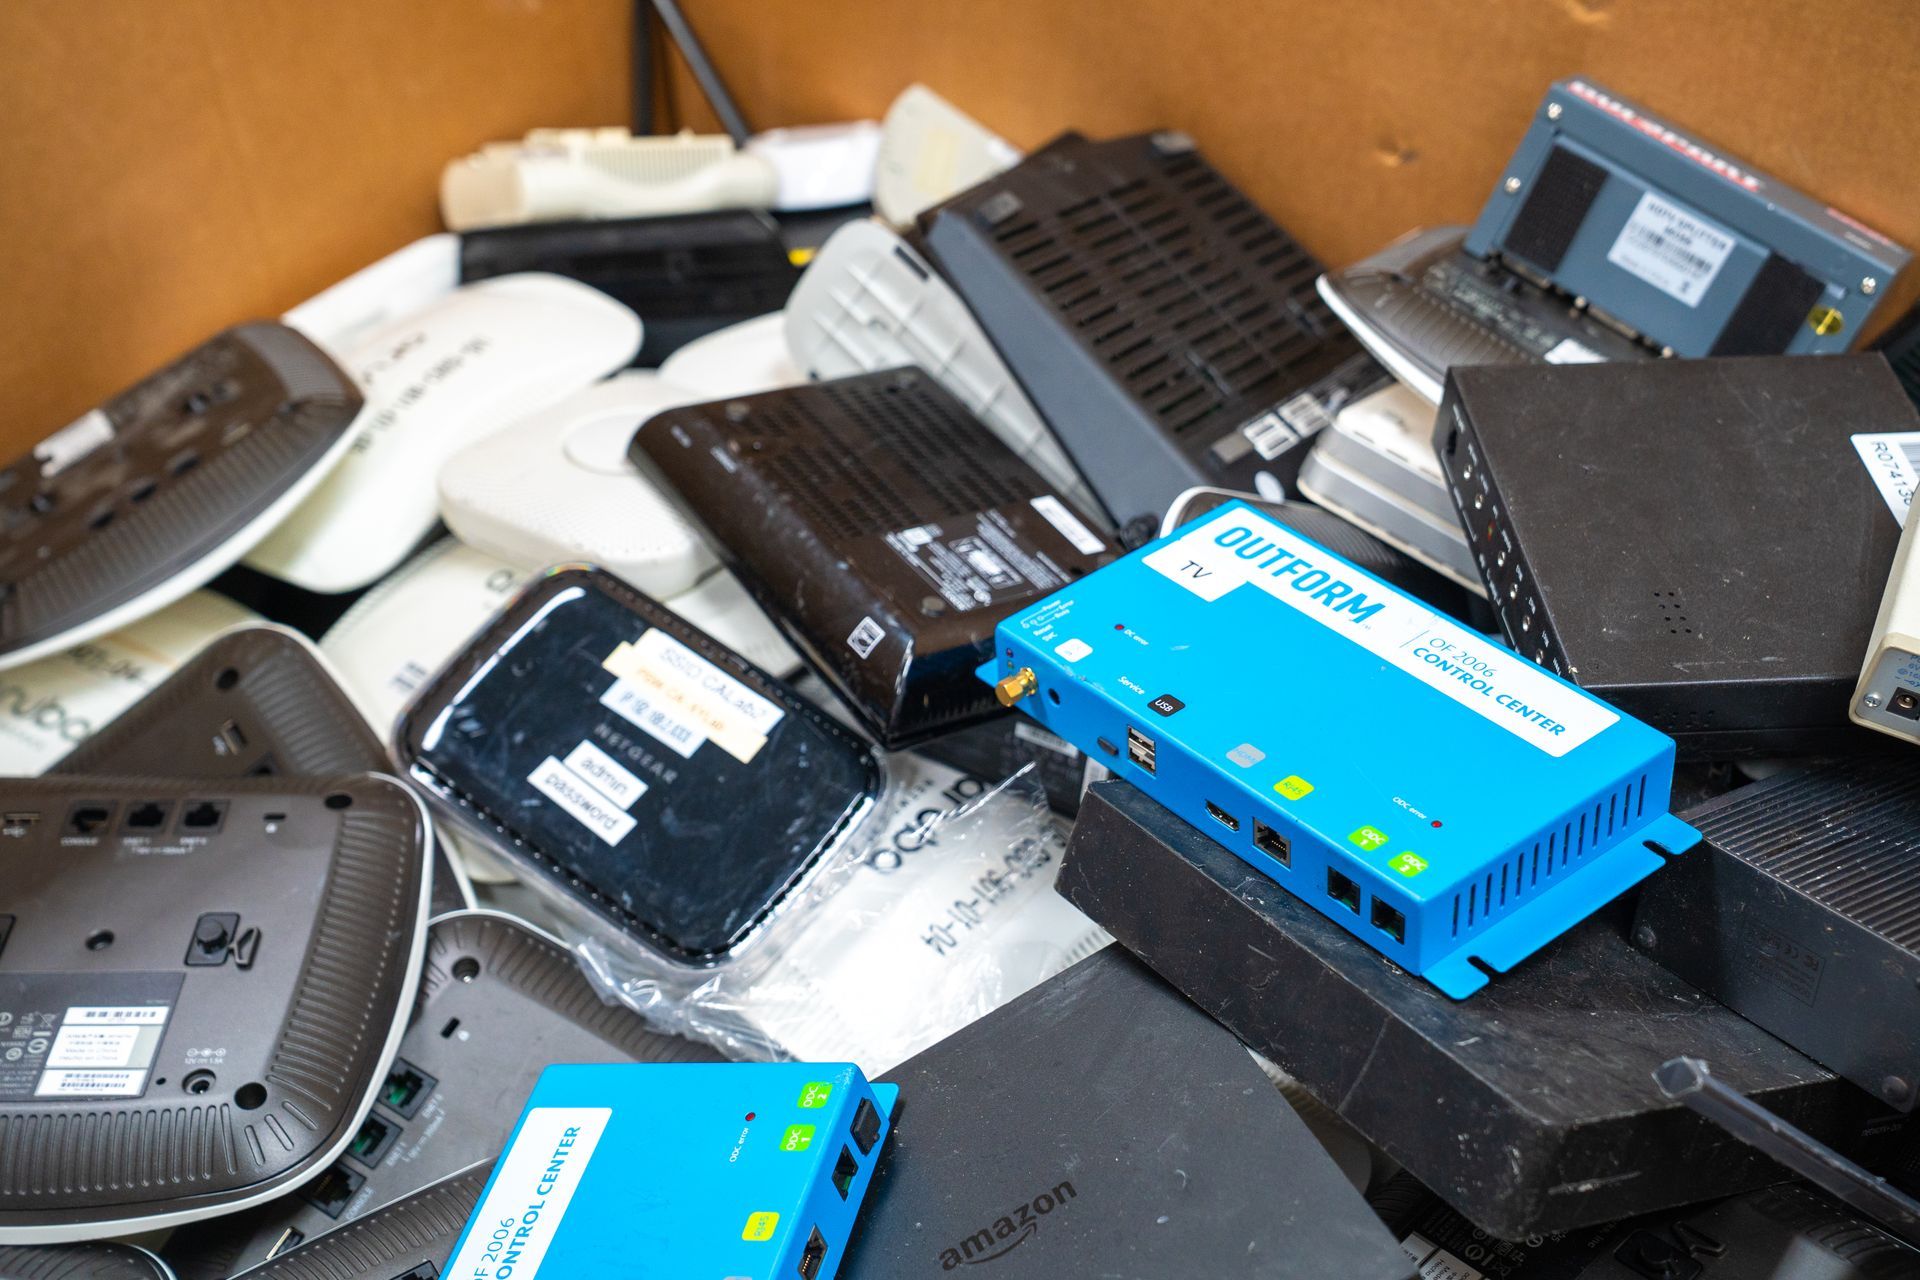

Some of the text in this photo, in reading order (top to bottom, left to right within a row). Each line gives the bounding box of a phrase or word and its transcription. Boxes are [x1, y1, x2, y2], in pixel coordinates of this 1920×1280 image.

[1179, 560, 1213, 579] TV
[1213, 525, 1387, 625] OUTFORM
[1132, 635, 1150, 646] error
[1428, 637, 1499, 679] OF 2006
[1117, 675, 1146, 695] Service
[1412, 646, 1496, 697] CONTROL
[1494, 694, 1567, 737] CENTER
[1153, 698, 1175, 713] USB
[594, 722, 679, 785] NETGEAR
[580, 757, 629, 797] admin
[543, 772, 620, 832] password
[1391, 796, 1427, 819] ODC error
[1361, 828, 1387, 846] ODC
[1401, 854, 1429, 872] ODC
[803, 1085, 820, 1108] ODC
[816, 1092, 828, 1101] 2
[728, 1126, 749, 1163] ODC error
[785, 1128, 802, 1152] ODC
[494, 1125, 582, 1280] ONTROL CENTER
[480, 1216, 516, 1263] 2006
[938, 1180, 1078, 1272] amazon
